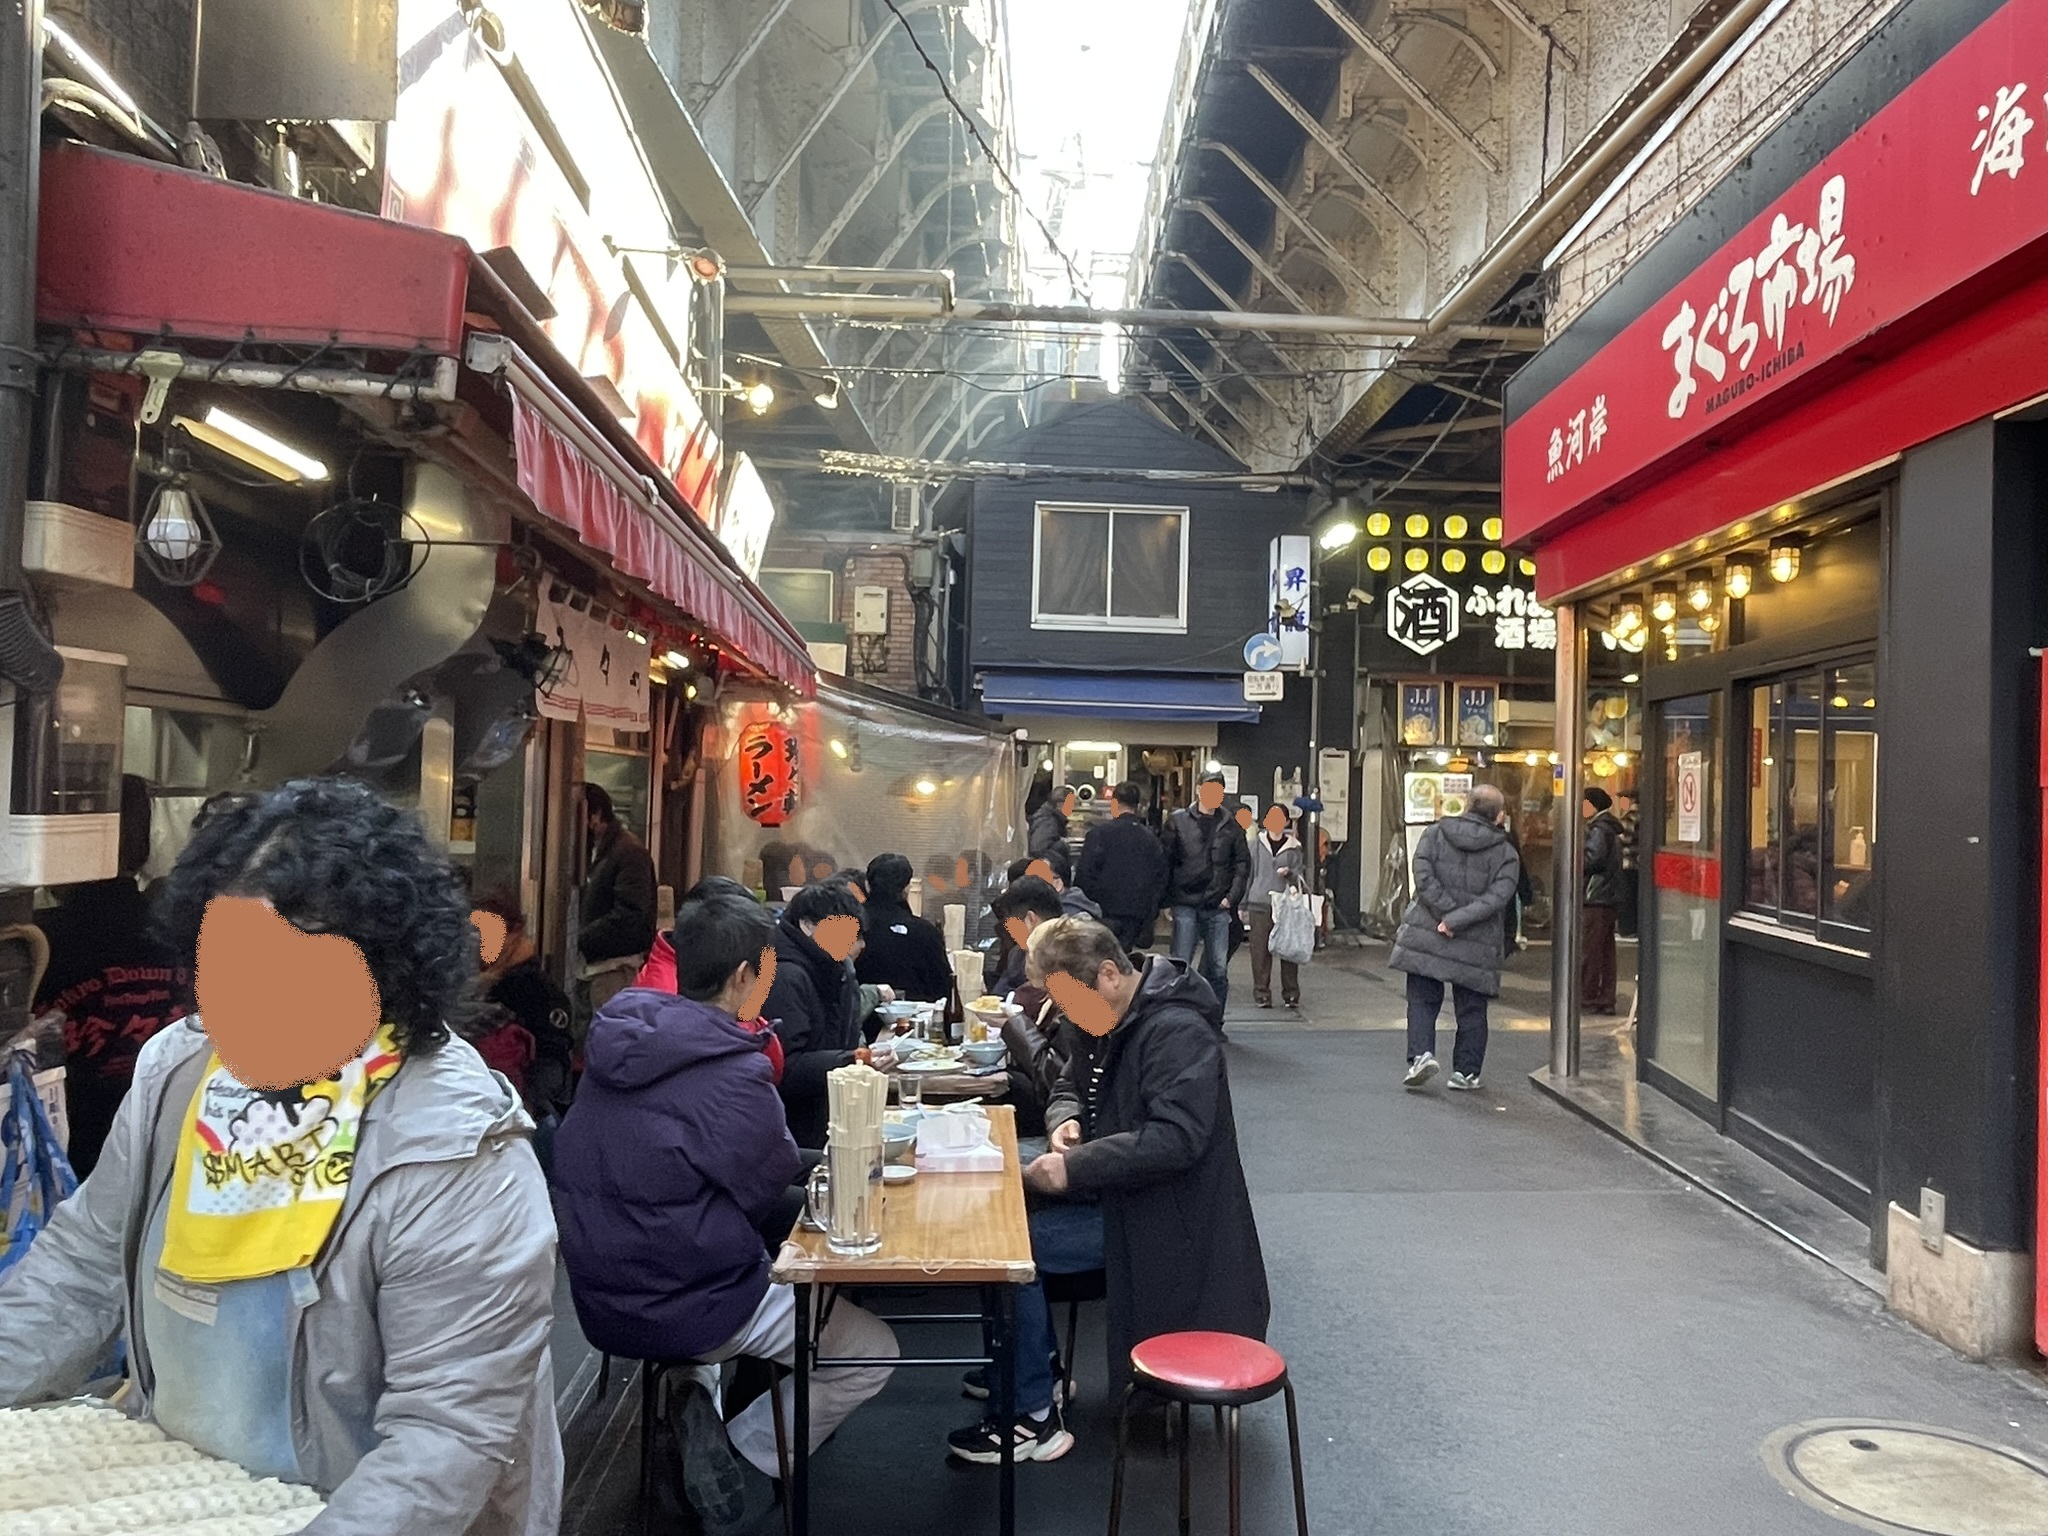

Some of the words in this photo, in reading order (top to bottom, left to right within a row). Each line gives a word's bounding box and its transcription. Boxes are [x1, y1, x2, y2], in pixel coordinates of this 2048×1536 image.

[1970, 82, 2048, 196] 海
[1662, 174, 1856, 419] まぐろ市場
[1705, 341, 1805, 415] MAGURO-ICHIBA
[1547, 394, 1608, 483] 魚河岸
[1495, 616, 1557, 650] 酒場
[744, 735, 774, 818] ラーメン
